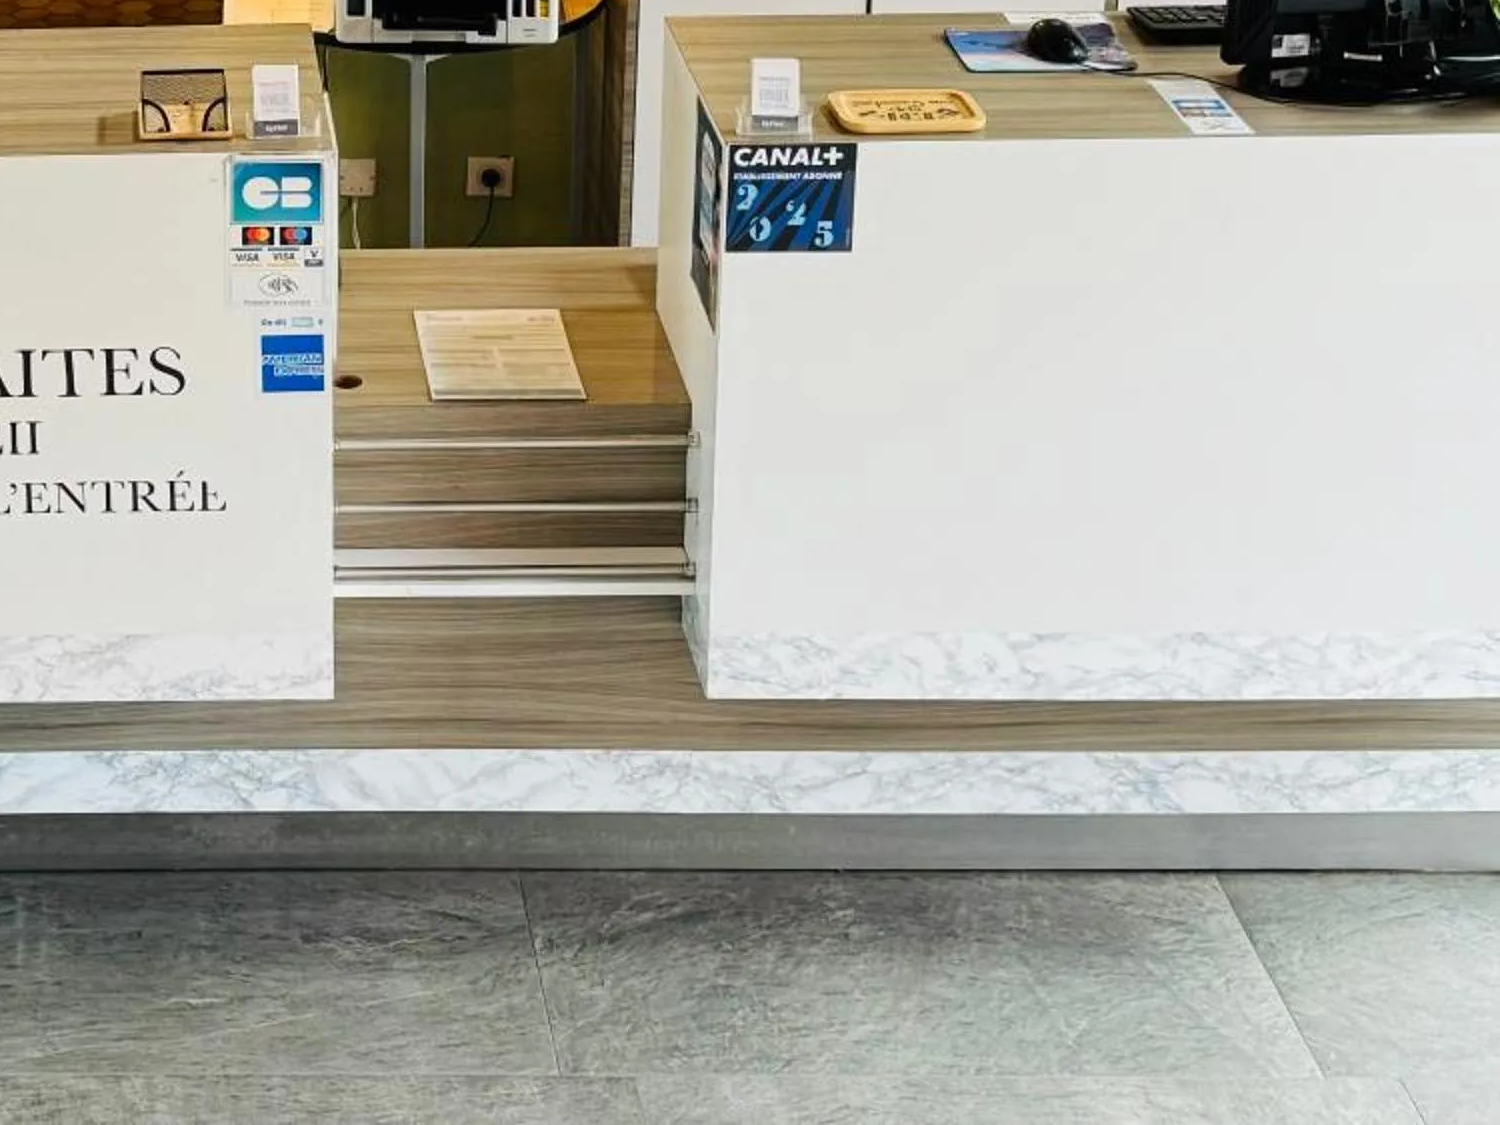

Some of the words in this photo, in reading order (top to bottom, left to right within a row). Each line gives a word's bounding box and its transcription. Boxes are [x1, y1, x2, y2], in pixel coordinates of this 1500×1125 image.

[734, 147, 844, 166] CANAL+
[236, 253, 259, 262] VISA
[273, 252, 295, 261] VISA
